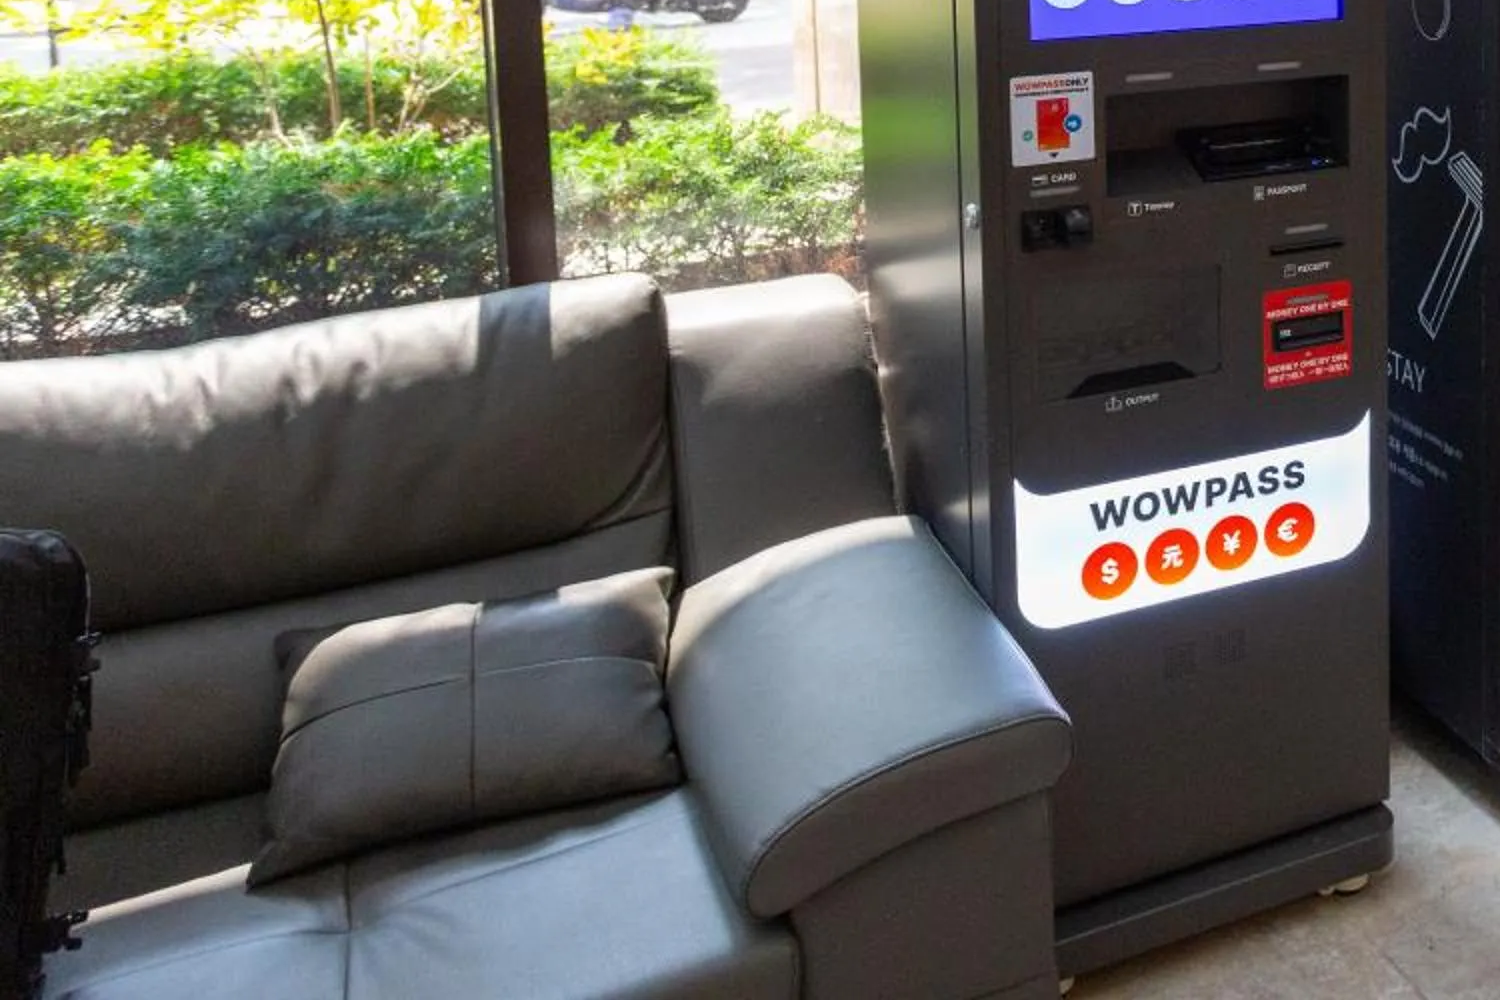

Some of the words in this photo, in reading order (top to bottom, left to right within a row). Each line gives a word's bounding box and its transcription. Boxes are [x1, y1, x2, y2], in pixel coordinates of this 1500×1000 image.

[1051, 172, 1077, 183] CARD
[1089, 460, 1306, 532] WOWPASS
[1101, 558, 1120, 585] $
[1222, 529, 1242, 556] ¥
[1276, 517, 1298, 543] €
